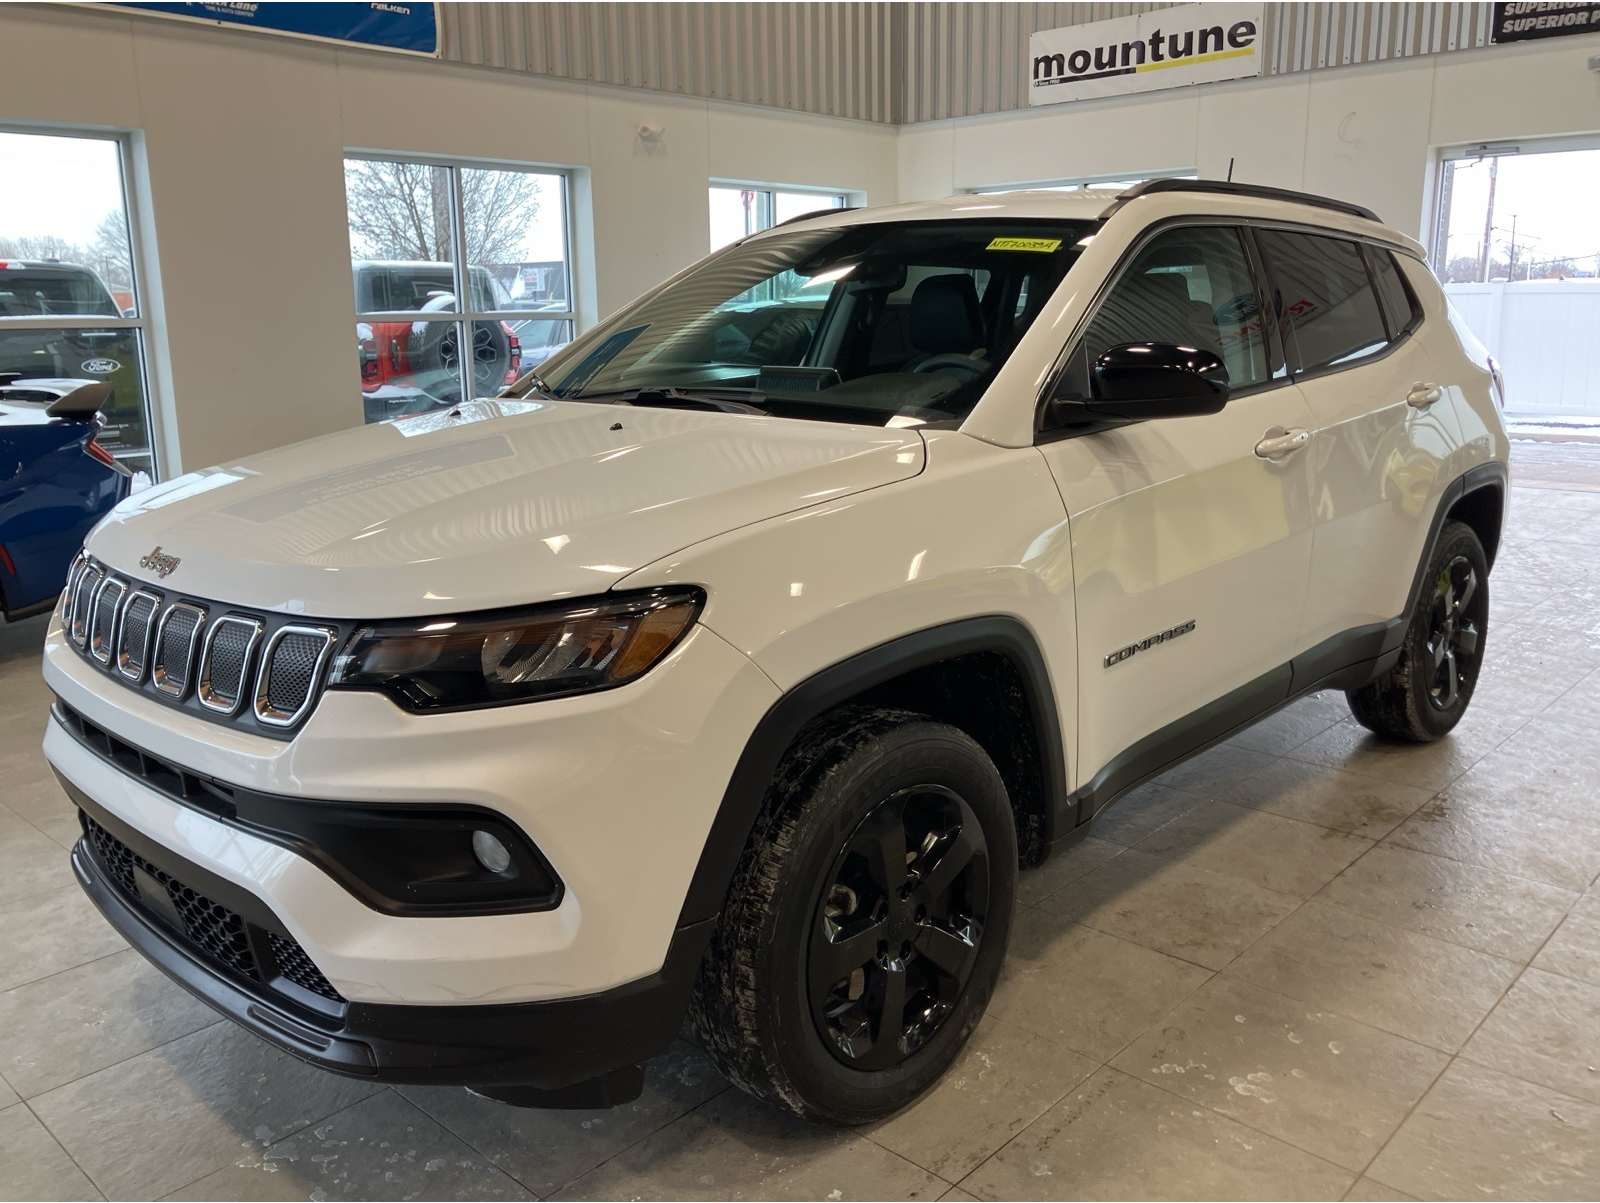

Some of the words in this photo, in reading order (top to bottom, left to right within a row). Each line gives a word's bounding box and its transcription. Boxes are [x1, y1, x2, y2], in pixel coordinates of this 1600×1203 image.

[1502, 11, 1588, 33] SUPERIOR
[1033, 20, 1257, 80] mountune
[139, 545, 181, 579] Jeep
[1103, 618, 1197, 669] COMPASS
